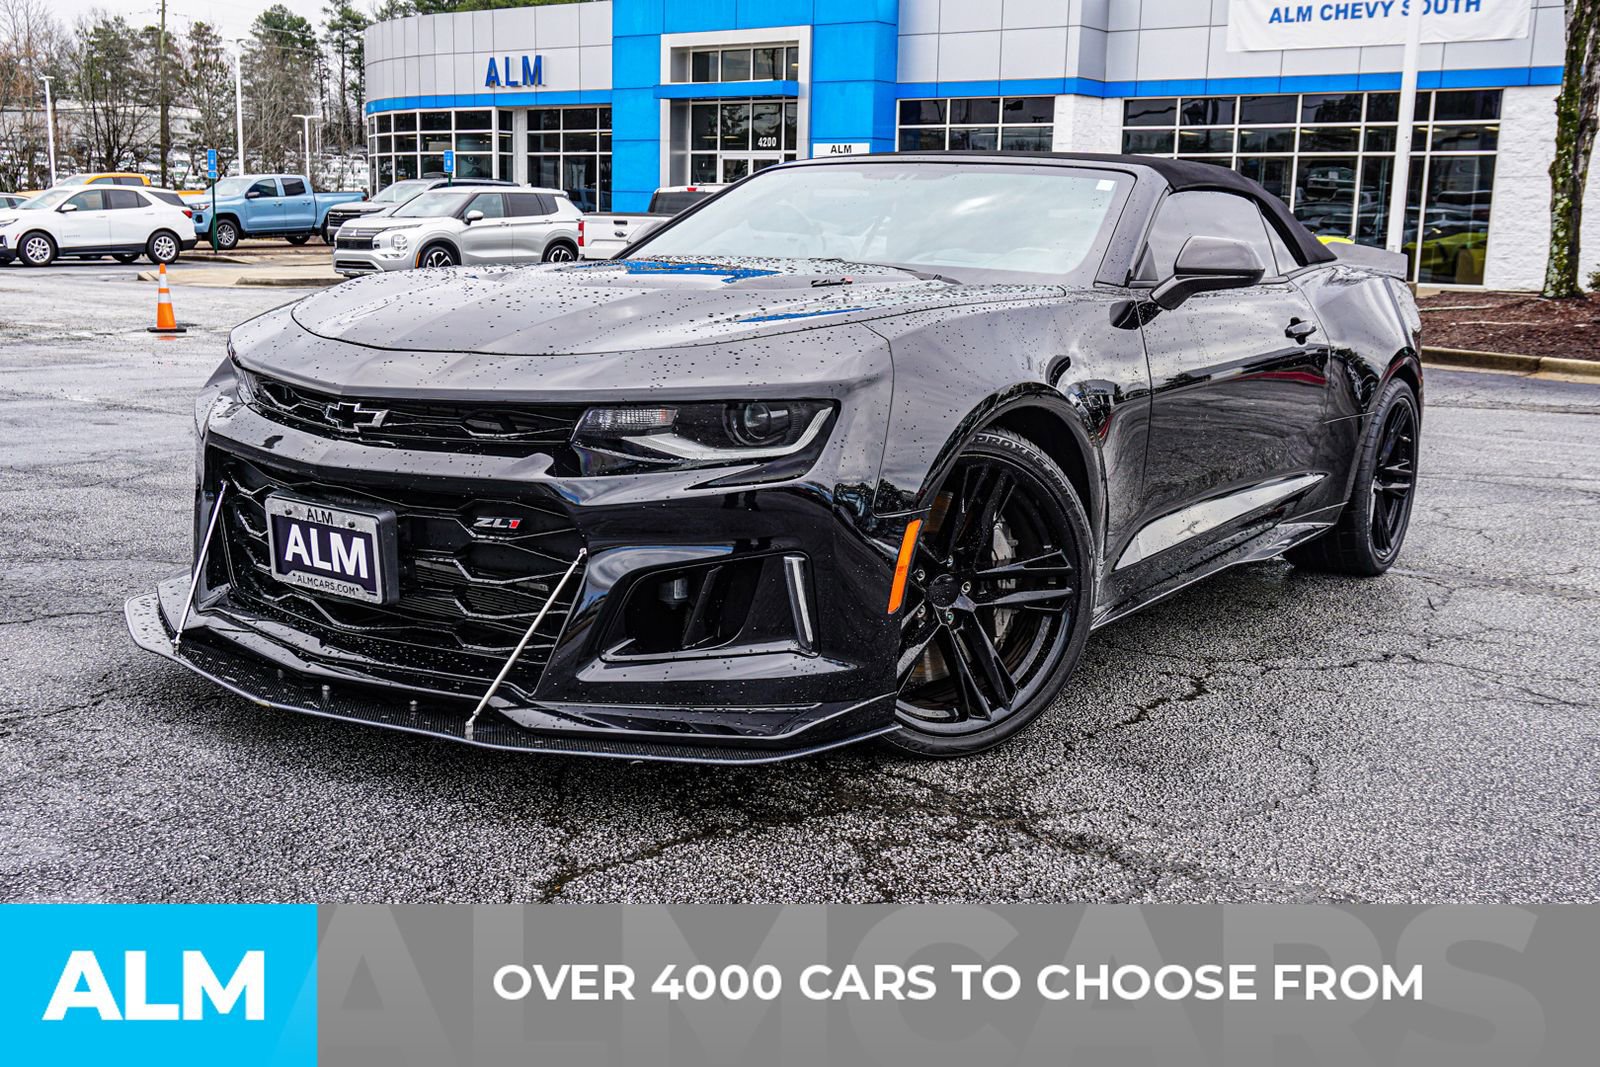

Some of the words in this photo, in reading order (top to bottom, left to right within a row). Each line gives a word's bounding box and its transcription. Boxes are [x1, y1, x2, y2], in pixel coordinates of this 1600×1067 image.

[1269, 4, 1313, 24] ALM
[1320, 1, 1394, 20] CHEVY
[484, 55, 543, 87] ALM
[757, 137, 777, 147] 4200
[830, 145, 852, 154] ALM
[306, 507, 334, 525] ALM
[473, 516, 521, 529] ZL1
[284, 523, 368, 579] ALM
